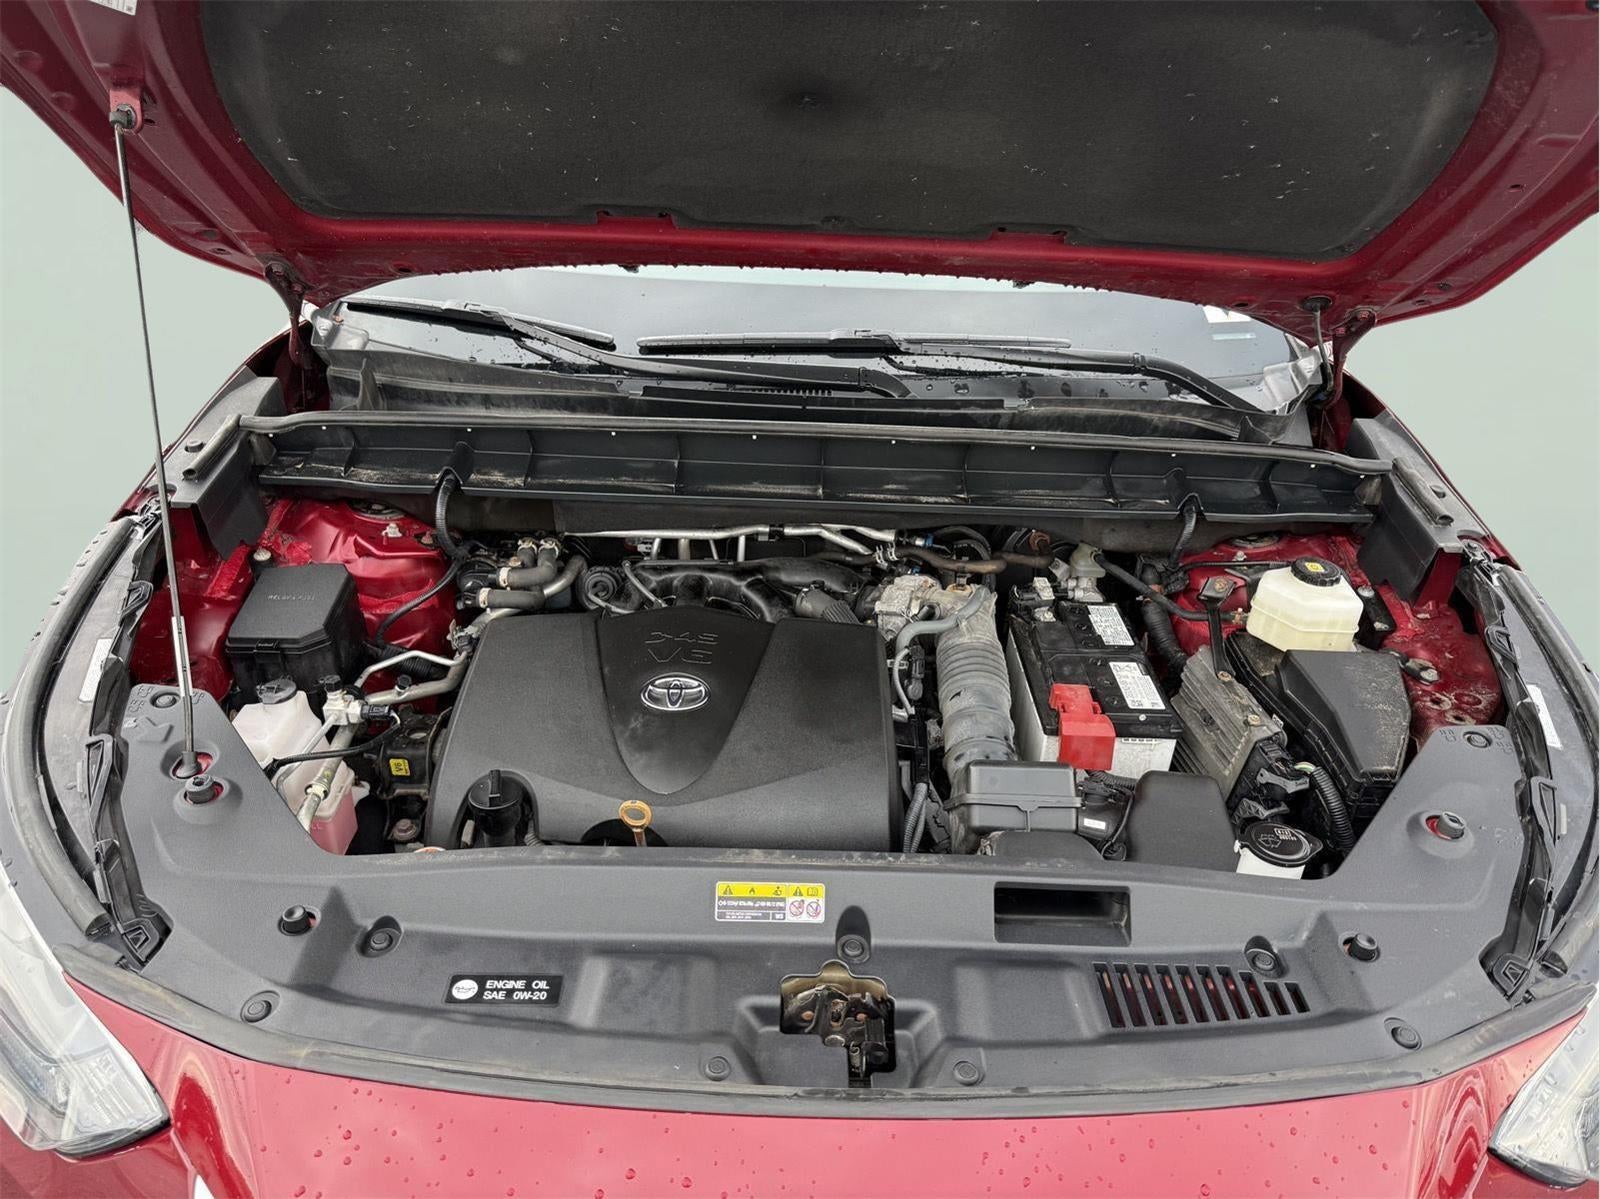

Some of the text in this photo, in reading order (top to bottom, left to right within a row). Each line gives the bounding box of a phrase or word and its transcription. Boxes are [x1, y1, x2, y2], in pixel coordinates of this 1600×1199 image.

[485, 979, 527, 989] ENGINE
[531, 980, 551, 990] OIL
[482, 990, 548, 1001] SAE 0W-20
